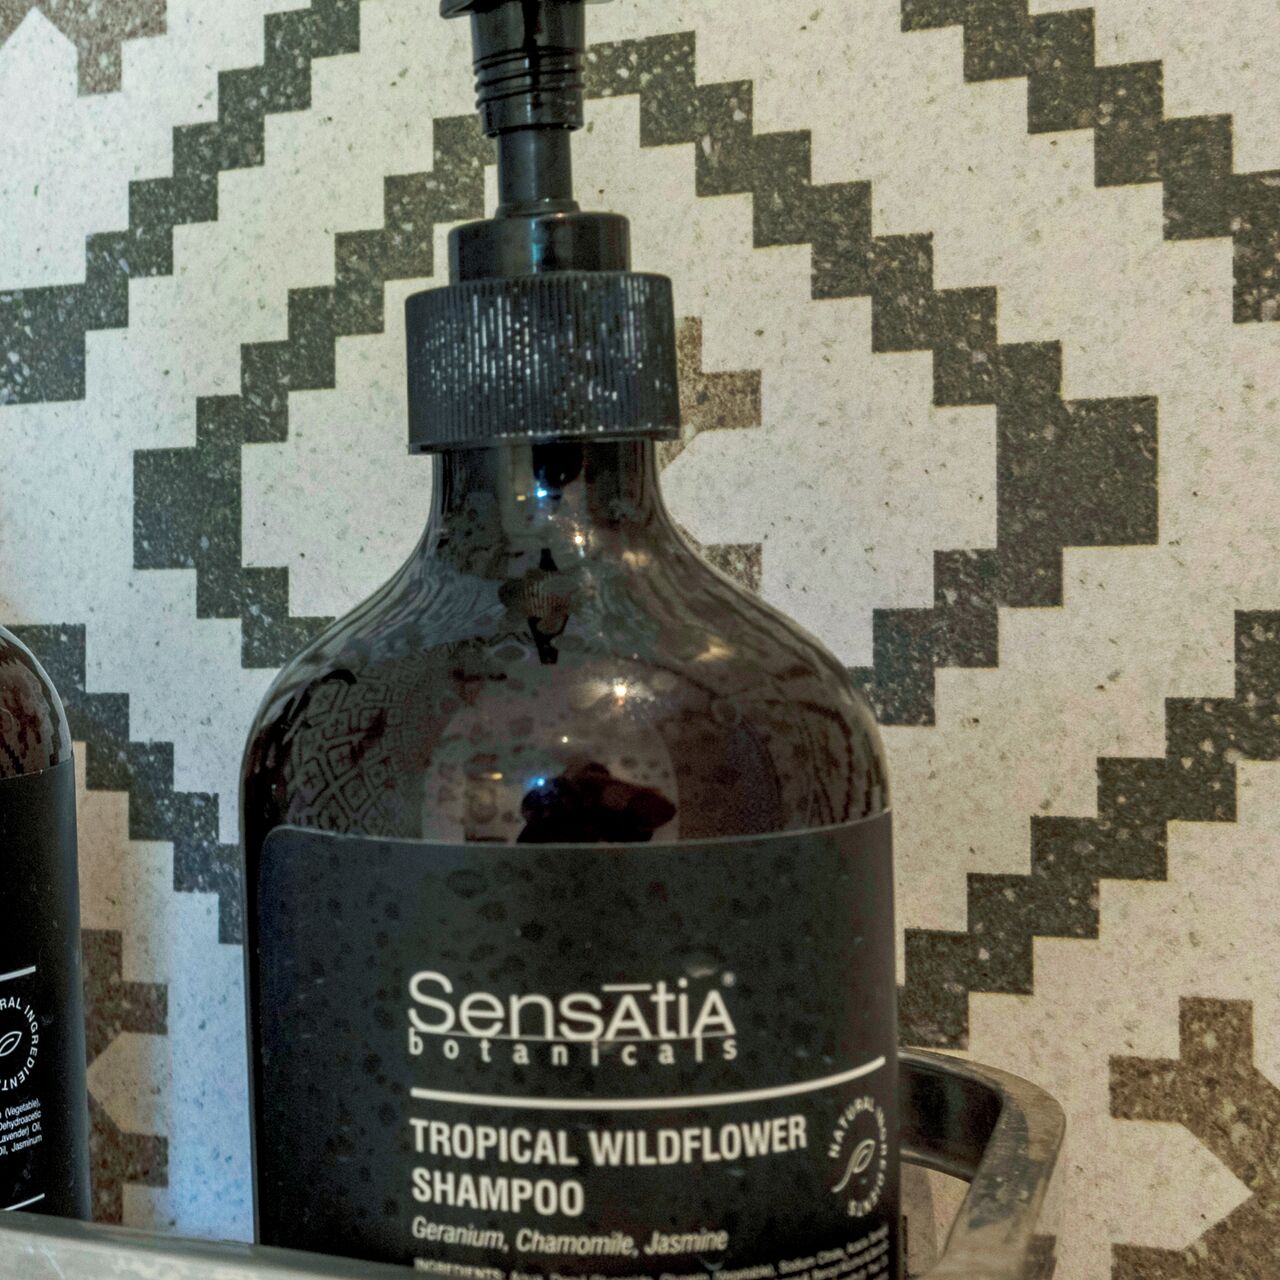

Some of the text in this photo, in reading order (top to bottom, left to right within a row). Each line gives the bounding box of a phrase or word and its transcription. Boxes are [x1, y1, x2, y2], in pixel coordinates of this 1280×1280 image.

[408, 1027, 738, 1066] botanicals
[11, 1134, 42, 1152] Jasminum
[32, 1122, 42, 1133] Oil,
[410, 1114, 807, 1167] TROPICAL WILDFLOWER
[412, 1168, 584, 1217] SHAMPOO
[412, 1217, 729, 1257] Geranium, Chamomile, Jasmine
